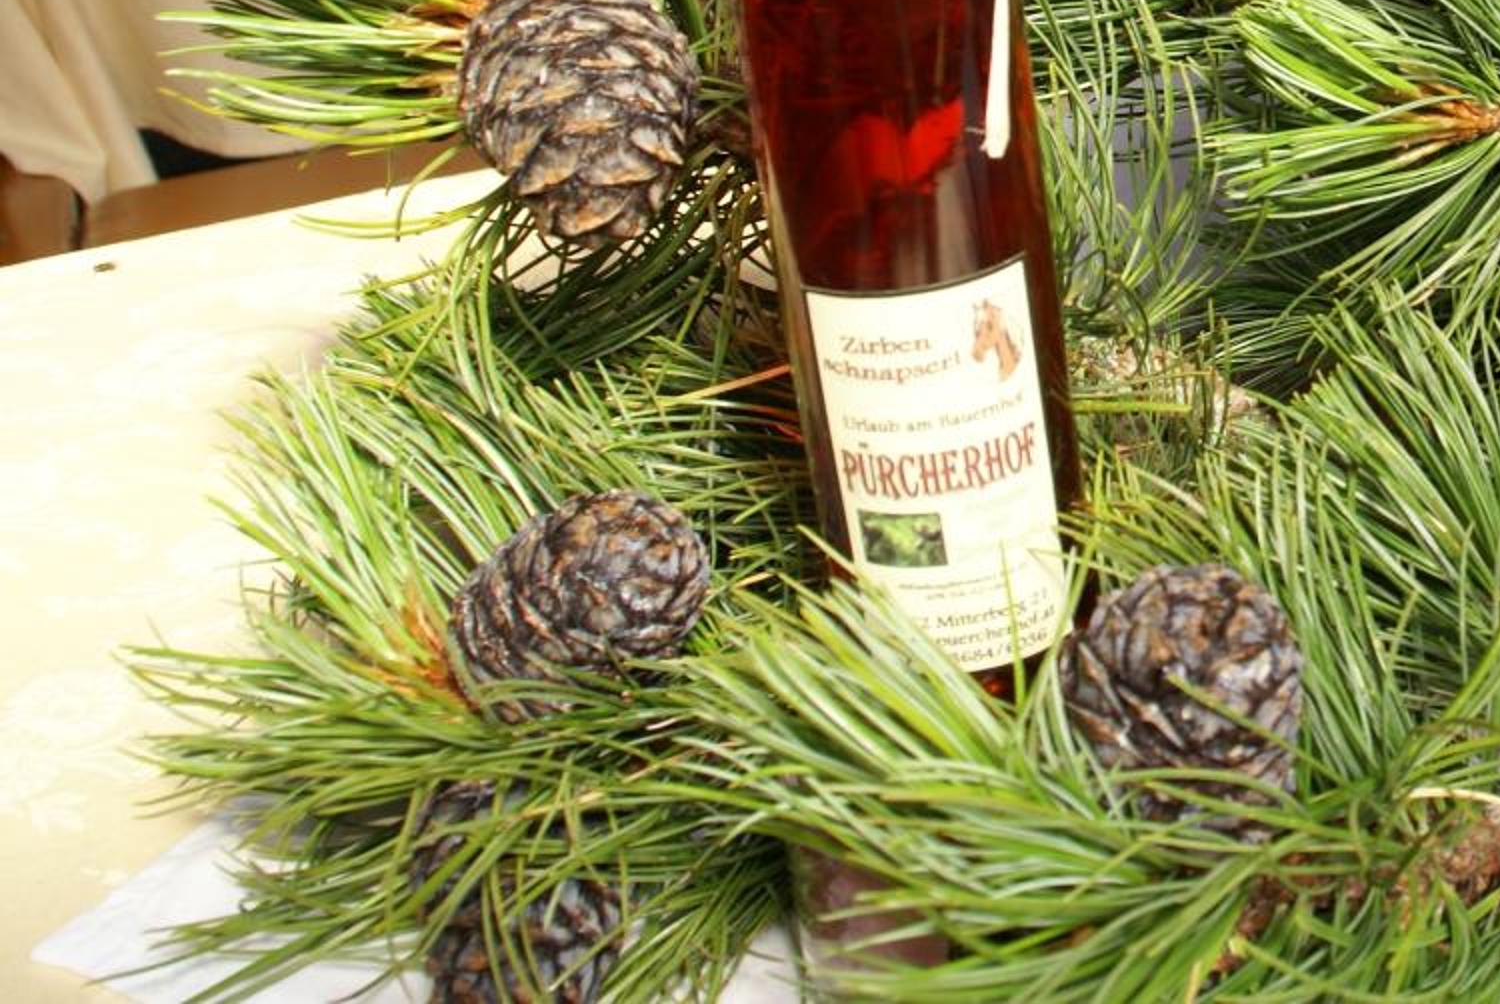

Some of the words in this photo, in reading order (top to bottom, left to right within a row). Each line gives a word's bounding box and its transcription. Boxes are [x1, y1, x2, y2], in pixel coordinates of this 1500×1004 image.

[840, 335, 930, 354] Zirben
[843, 415, 899, 433] Urlaub
[906, 420, 932, 432] am
[841, 422, 1034, 500] PÜRCHERHOF
